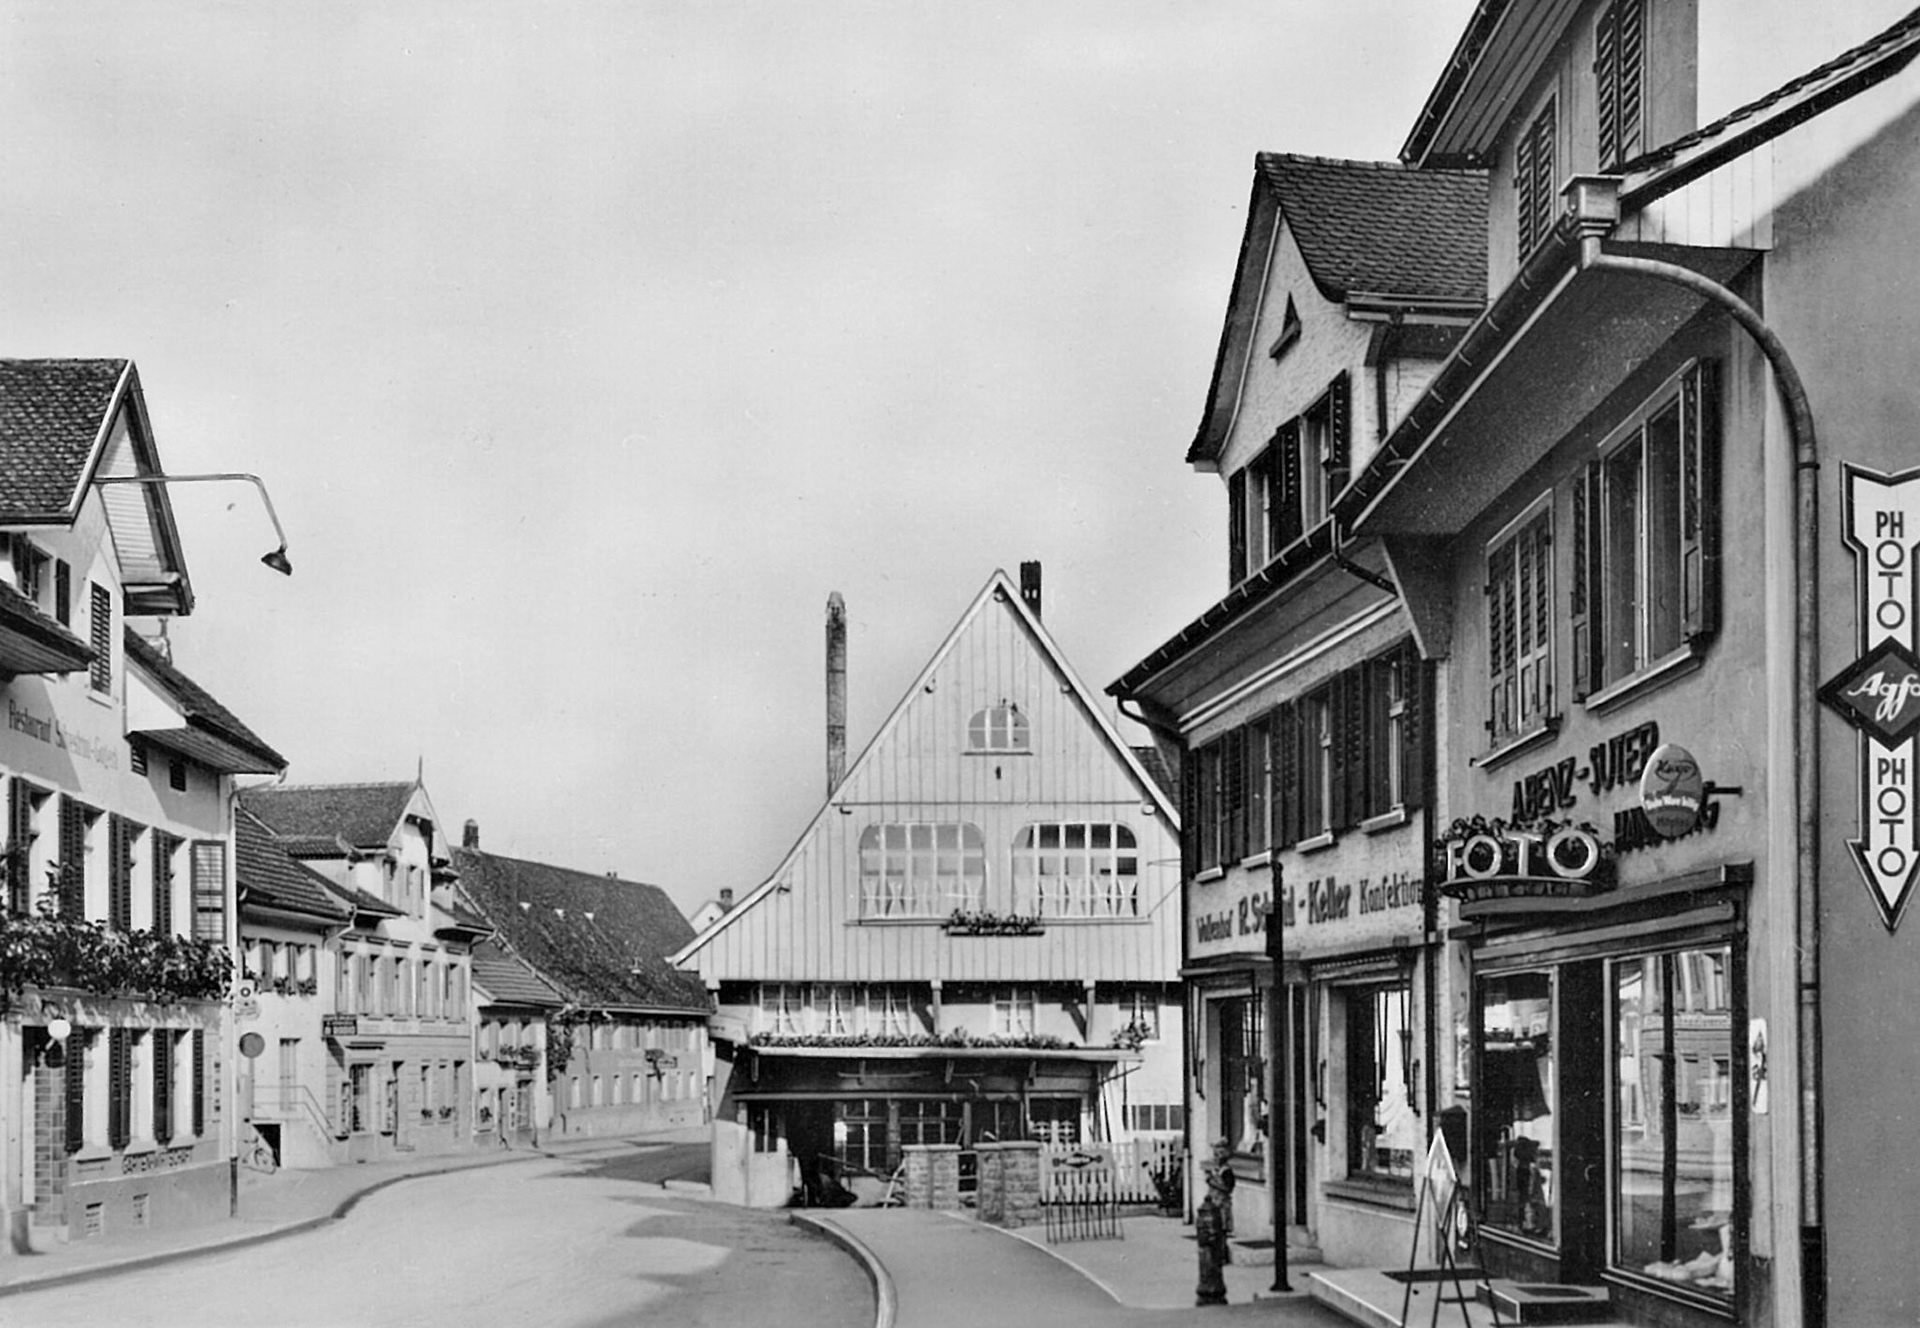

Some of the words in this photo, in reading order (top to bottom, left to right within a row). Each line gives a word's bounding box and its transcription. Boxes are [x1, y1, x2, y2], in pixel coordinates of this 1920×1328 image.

[1876, 511, 1905, 630] PHOTO
[1447, 830, 1599, 882] FOTO
[1877, 758, 1906, 878] PHOTO
